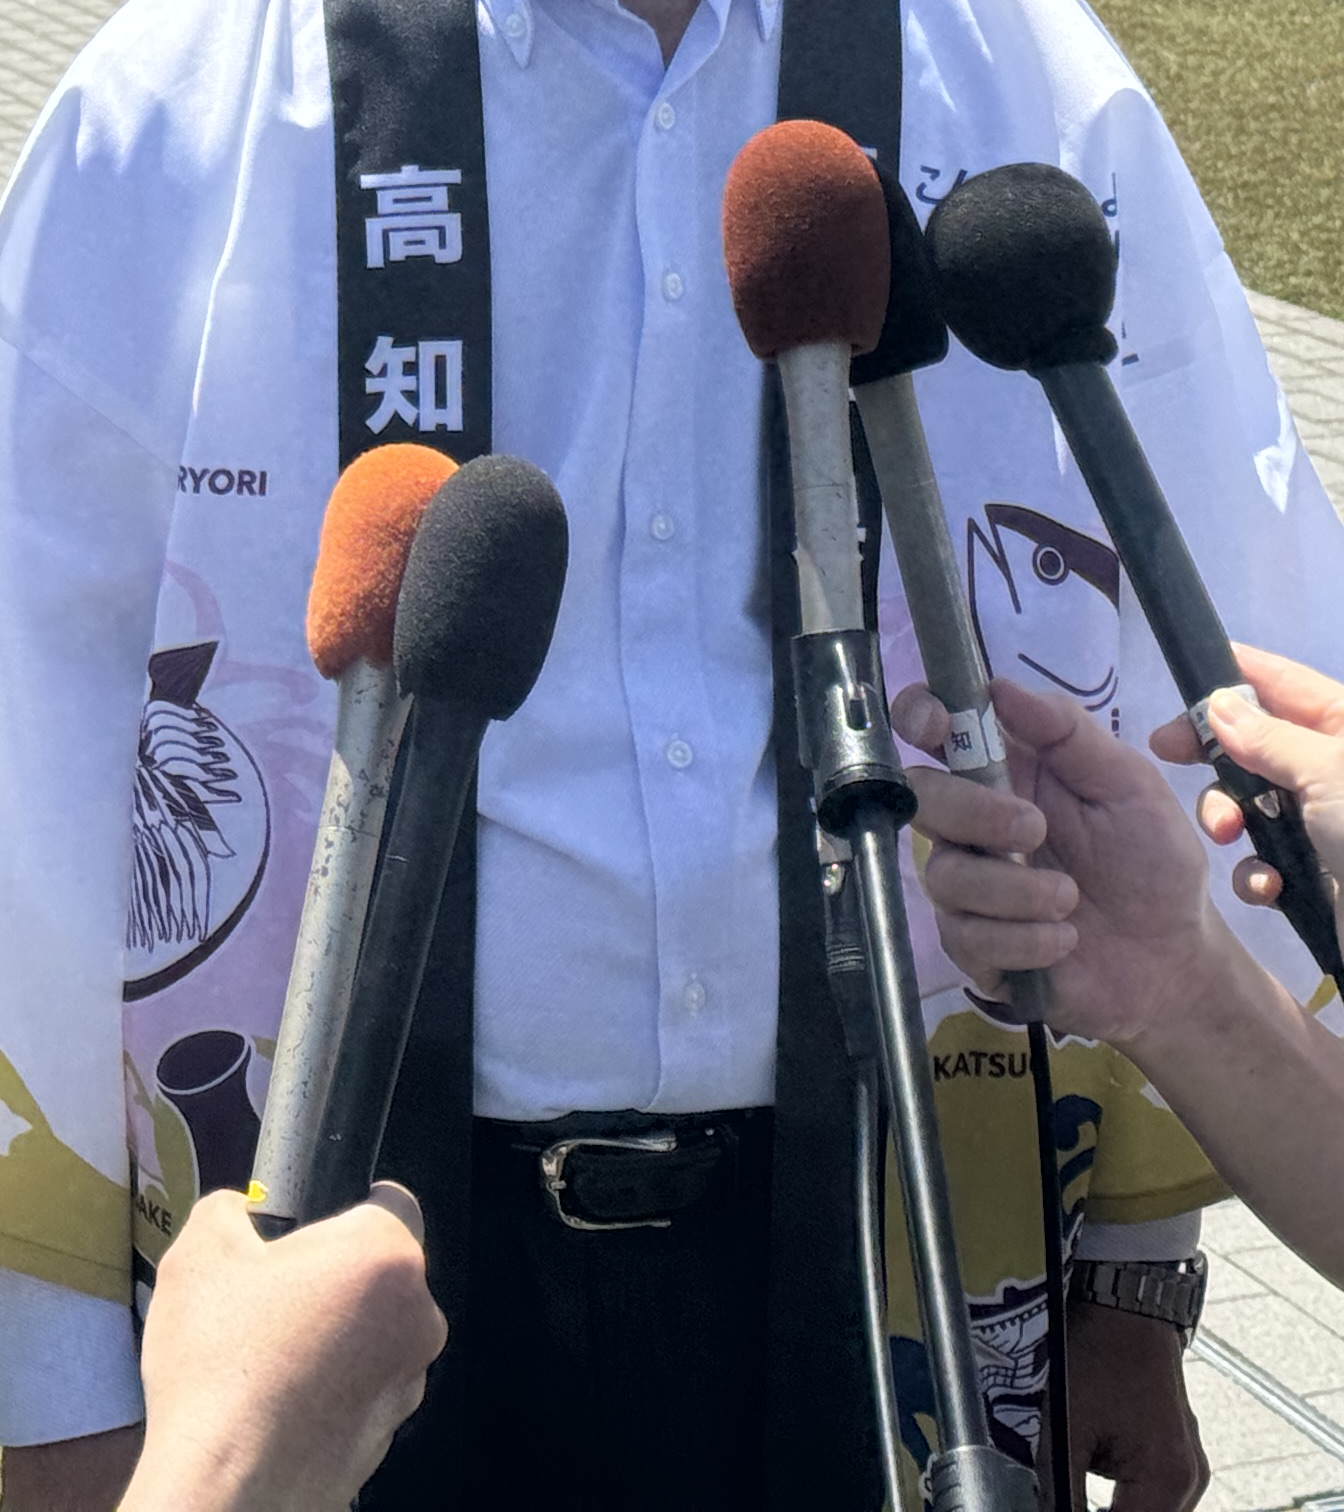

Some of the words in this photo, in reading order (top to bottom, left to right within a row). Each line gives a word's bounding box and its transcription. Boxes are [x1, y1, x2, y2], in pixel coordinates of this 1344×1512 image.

[359, 163, 465, 436] 高知
[177, 465, 268, 497] RYORI
[933, 1050, 1032, 1082] KATSU
[136, 1192, 173, 1238] AKE
